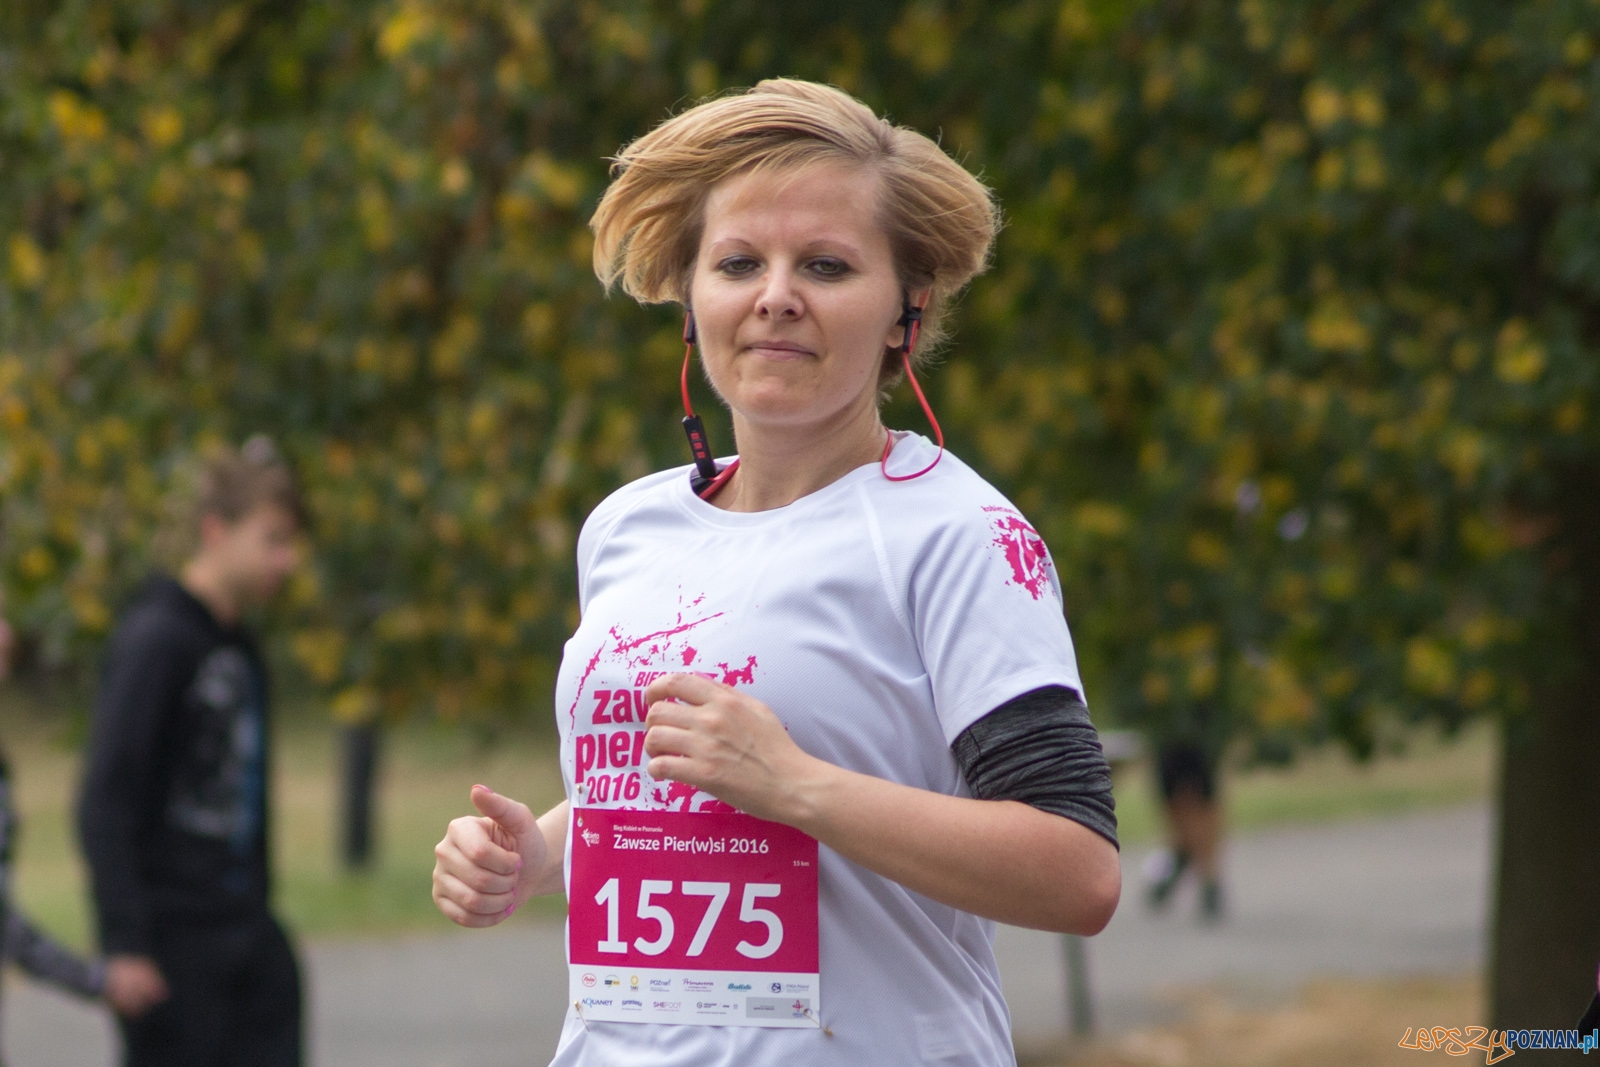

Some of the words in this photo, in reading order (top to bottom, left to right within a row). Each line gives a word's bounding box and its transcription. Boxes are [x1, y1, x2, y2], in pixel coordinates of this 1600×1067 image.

[634, 671, 667, 687] BIE
[592, 689, 649, 725] zaw
[575, 731, 648, 784] pier
[586, 772, 641, 805] 2016
[613, 834, 660, 850] Zawsze
[663, 836, 726, 855] Pier(w)si
[729, 838, 769, 854] 2016
[594, 878, 784, 959] 1575
